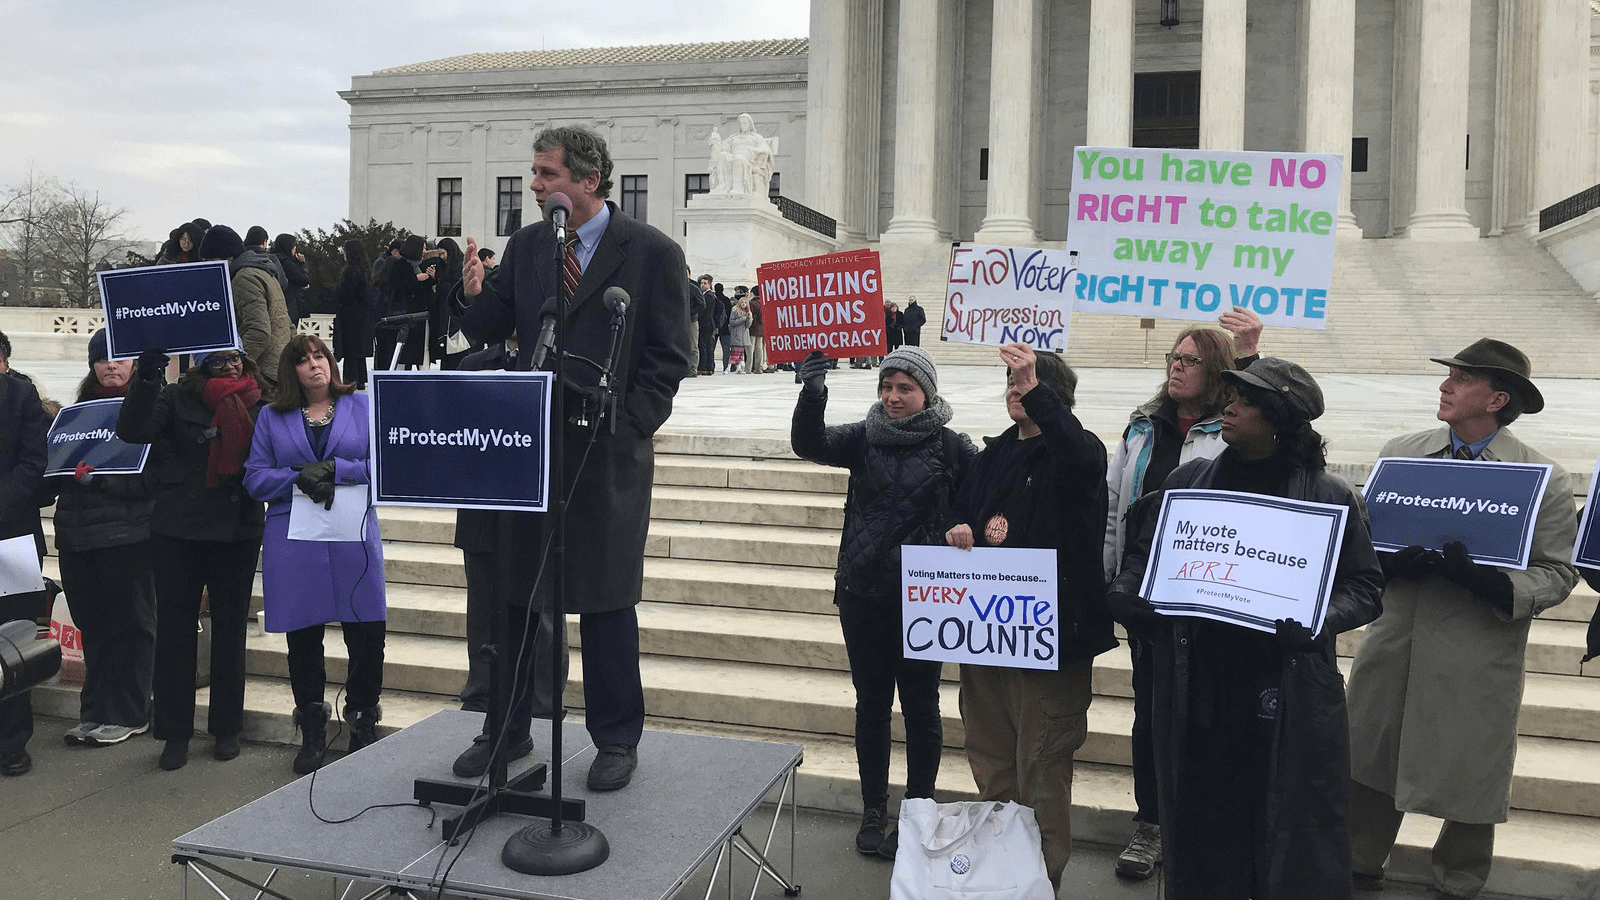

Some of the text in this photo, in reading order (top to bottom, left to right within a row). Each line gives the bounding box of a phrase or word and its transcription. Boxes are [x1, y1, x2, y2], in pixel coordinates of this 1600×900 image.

[1077, 150, 1327, 189] You have NO
[1077, 193, 1333, 235] RIGHT to take
[772, 255, 860, 271] DEMOCRACY INITIATIVE
[1113, 237, 1295, 277] away my
[949, 248, 1077, 293] End Voter
[765, 269, 878, 302] MOBILIZING
[1075, 272, 1328, 319] RIGHT TO VOTE
[115, 300, 221, 320] #ProtectMyVote
[776, 299, 866, 329] MILLIONS
[945, 291, 1065, 342] Suppression
[770, 328, 882, 352] FOR DEMOCRACY
[52, 428, 119, 445] #ProtectMy
[388, 426, 533, 452] #ProtectMyVote
[1375, 490, 1520, 516] #ProtectMyVote
[1175, 520, 1238, 539] My vote
[1172, 537, 1308, 570] matters because
[908, 569, 935, 581] Voting
[936, 570, 970, 580] Matters
[972, 572, 981, 580] to
[1176, 560, 1240, 582] APRI
[907, 585, 968, 605] EVERY
[1196, 588, 1251, 604] #ProtectMyVote
